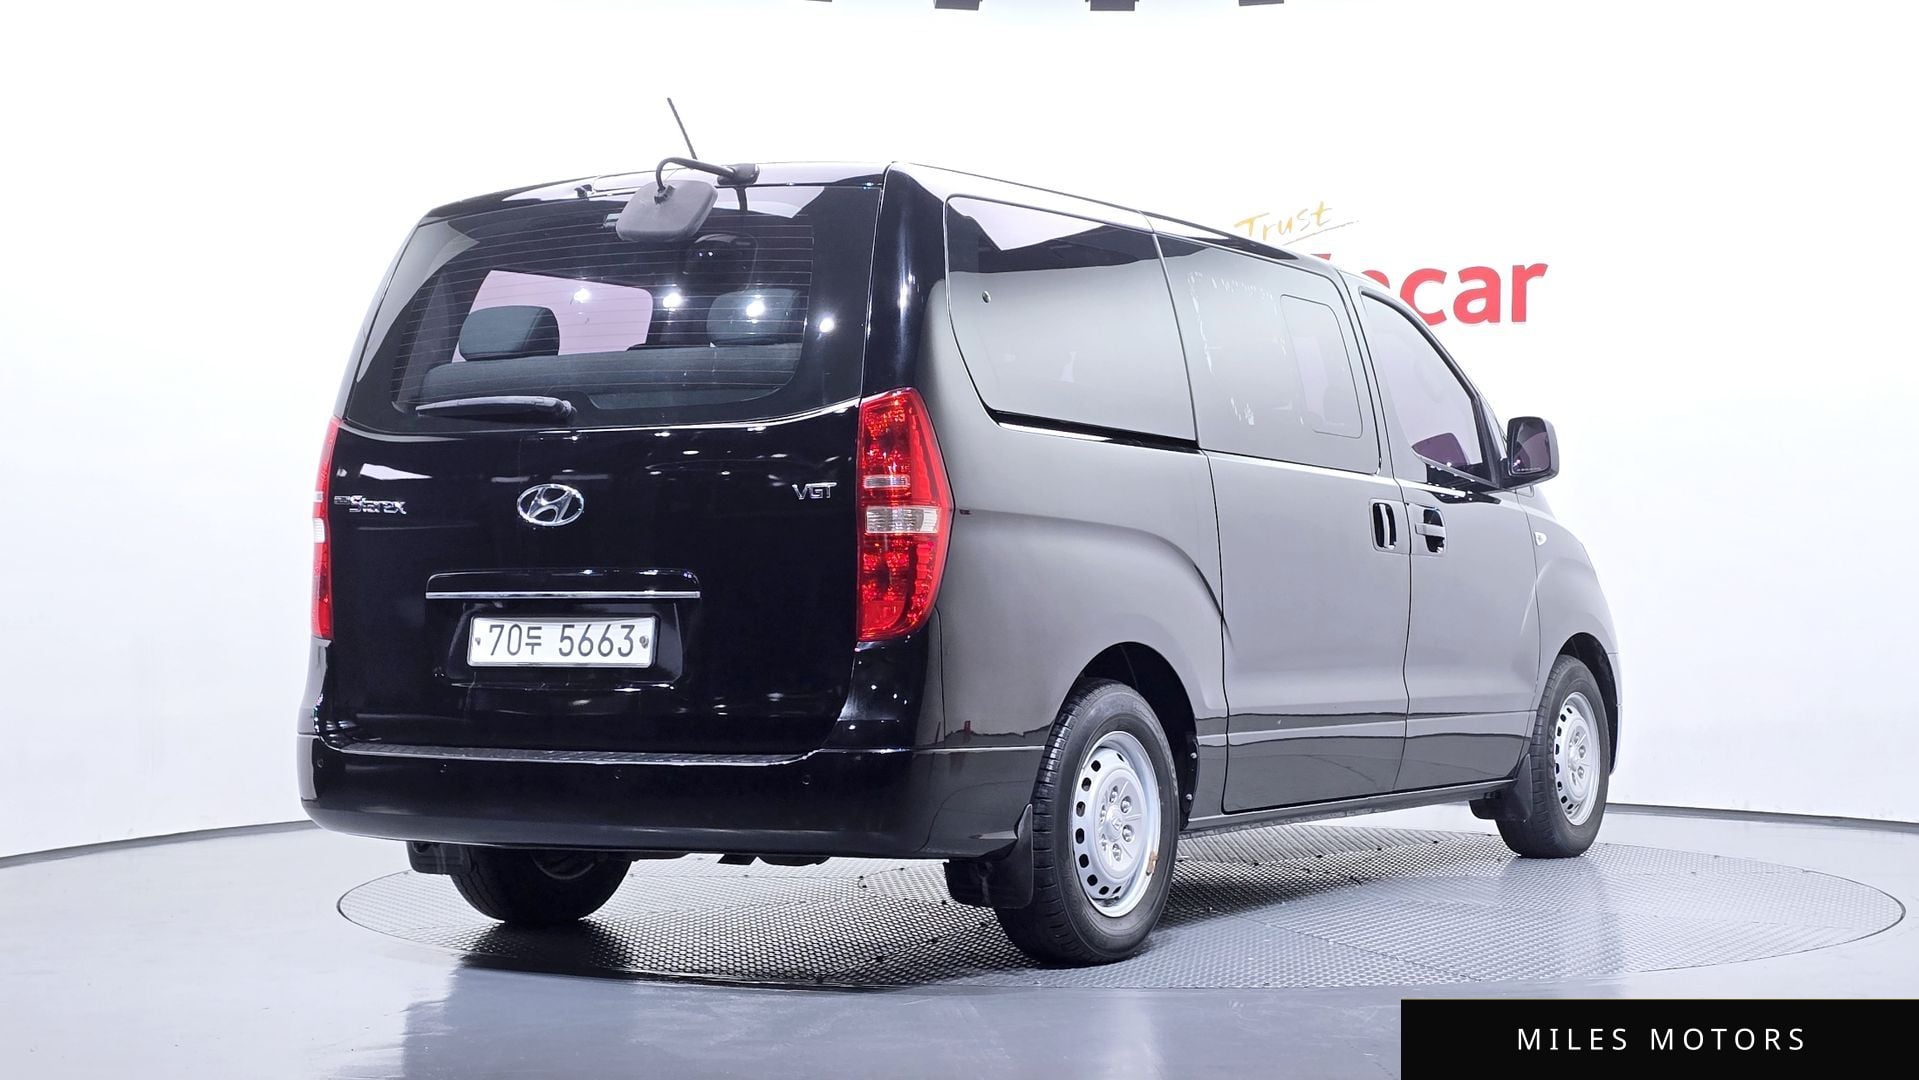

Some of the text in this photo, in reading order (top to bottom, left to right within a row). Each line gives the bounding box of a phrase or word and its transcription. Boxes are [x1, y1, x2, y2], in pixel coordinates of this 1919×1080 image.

[1233, 200, 1334, 241] Trust
[1310, 253, 1549, 327] car
[791, 482, 838, 500] VGT
[489, 624, 636, 657] 70두 5663
